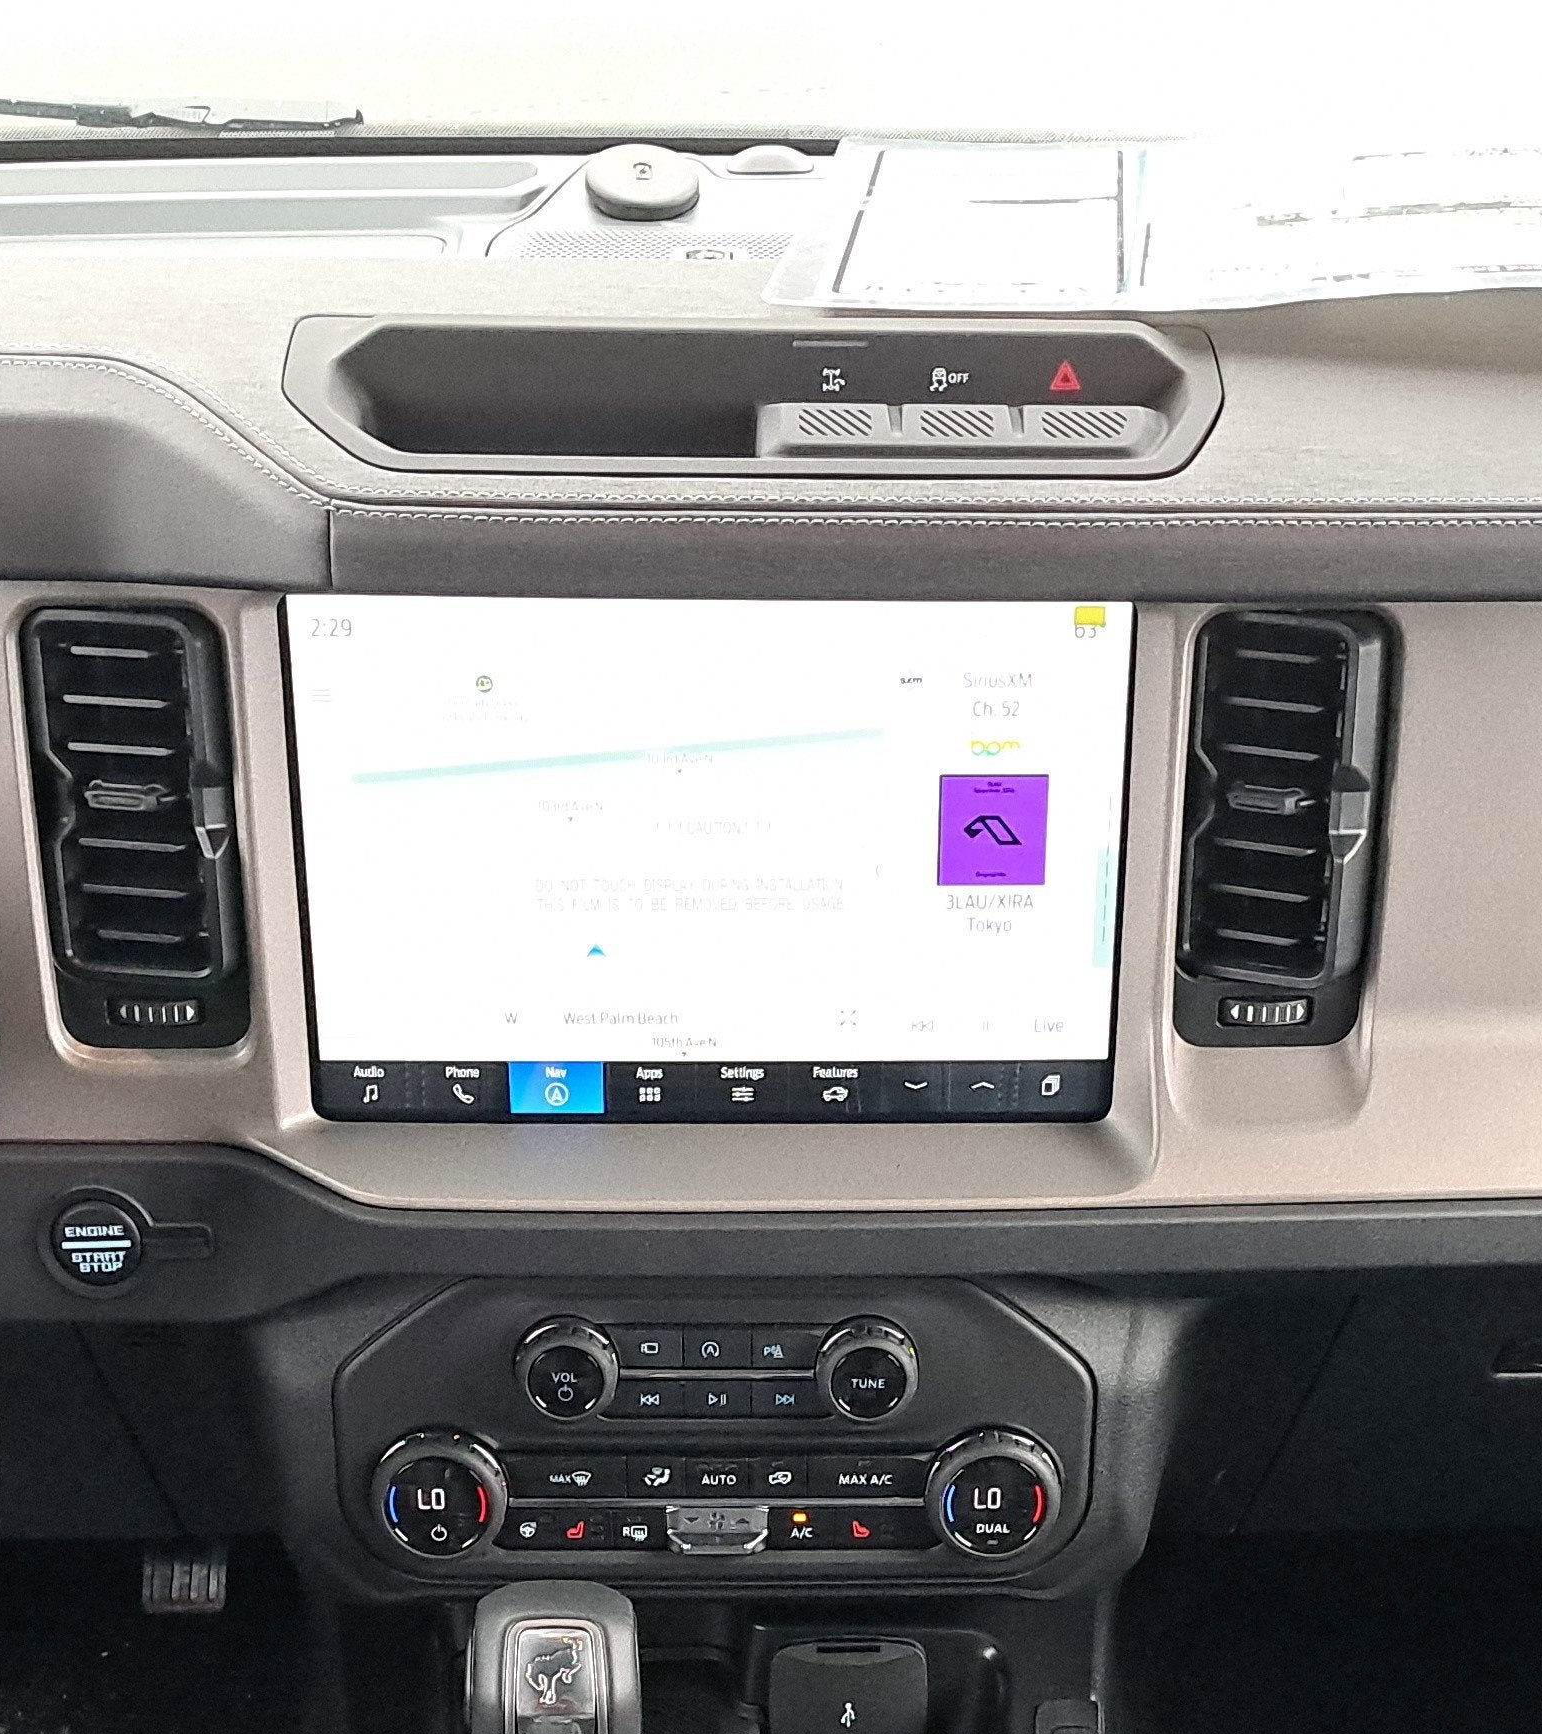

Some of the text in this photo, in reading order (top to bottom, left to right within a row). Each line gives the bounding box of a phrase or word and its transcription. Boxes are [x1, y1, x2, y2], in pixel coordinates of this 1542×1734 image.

[948, 372, 970, 385] OFF
[310, 618, 353, 638] 2:29
[963, 672, 1034, 689] SiriusXM
[1002, 701, 1020, 717] 52
[967, 917, 1012, 934] Tokyo
[504, 1012, 518, 1025] W
[563, 1011, 679, 1025] West Palm Beach
[1033, 1018, 1065, 1034] Live
[353, 1065, 385, 1080] Audio
[445, 1065, 480, 1080] Phone
[545, 1066, 568, 1079] Nav
[636, 1066, 664, 1083] Apps
[720, 1066, 765, 1081] Settings
[812, 1065, 859, 1079] Features
[64, 1224, 125, 1238] ENGINE
[71, 1251, 126, 1263] START
[80, 1262, 122, 1273] STOP
[551, 1372, 578, 1384] VOL
[851, 1378, 886, 1389] TUNE
[701, 1473, 737, 1486] AUTO
[839, 1473, 894, 1486] MAX A/C
[416, 1487, 446, 1511] LO
[973, 1486, 1002, 1510] LO
[789, 1526, 815, 1539] A/C
[976, 1523, 1011, 1534] DUAL
